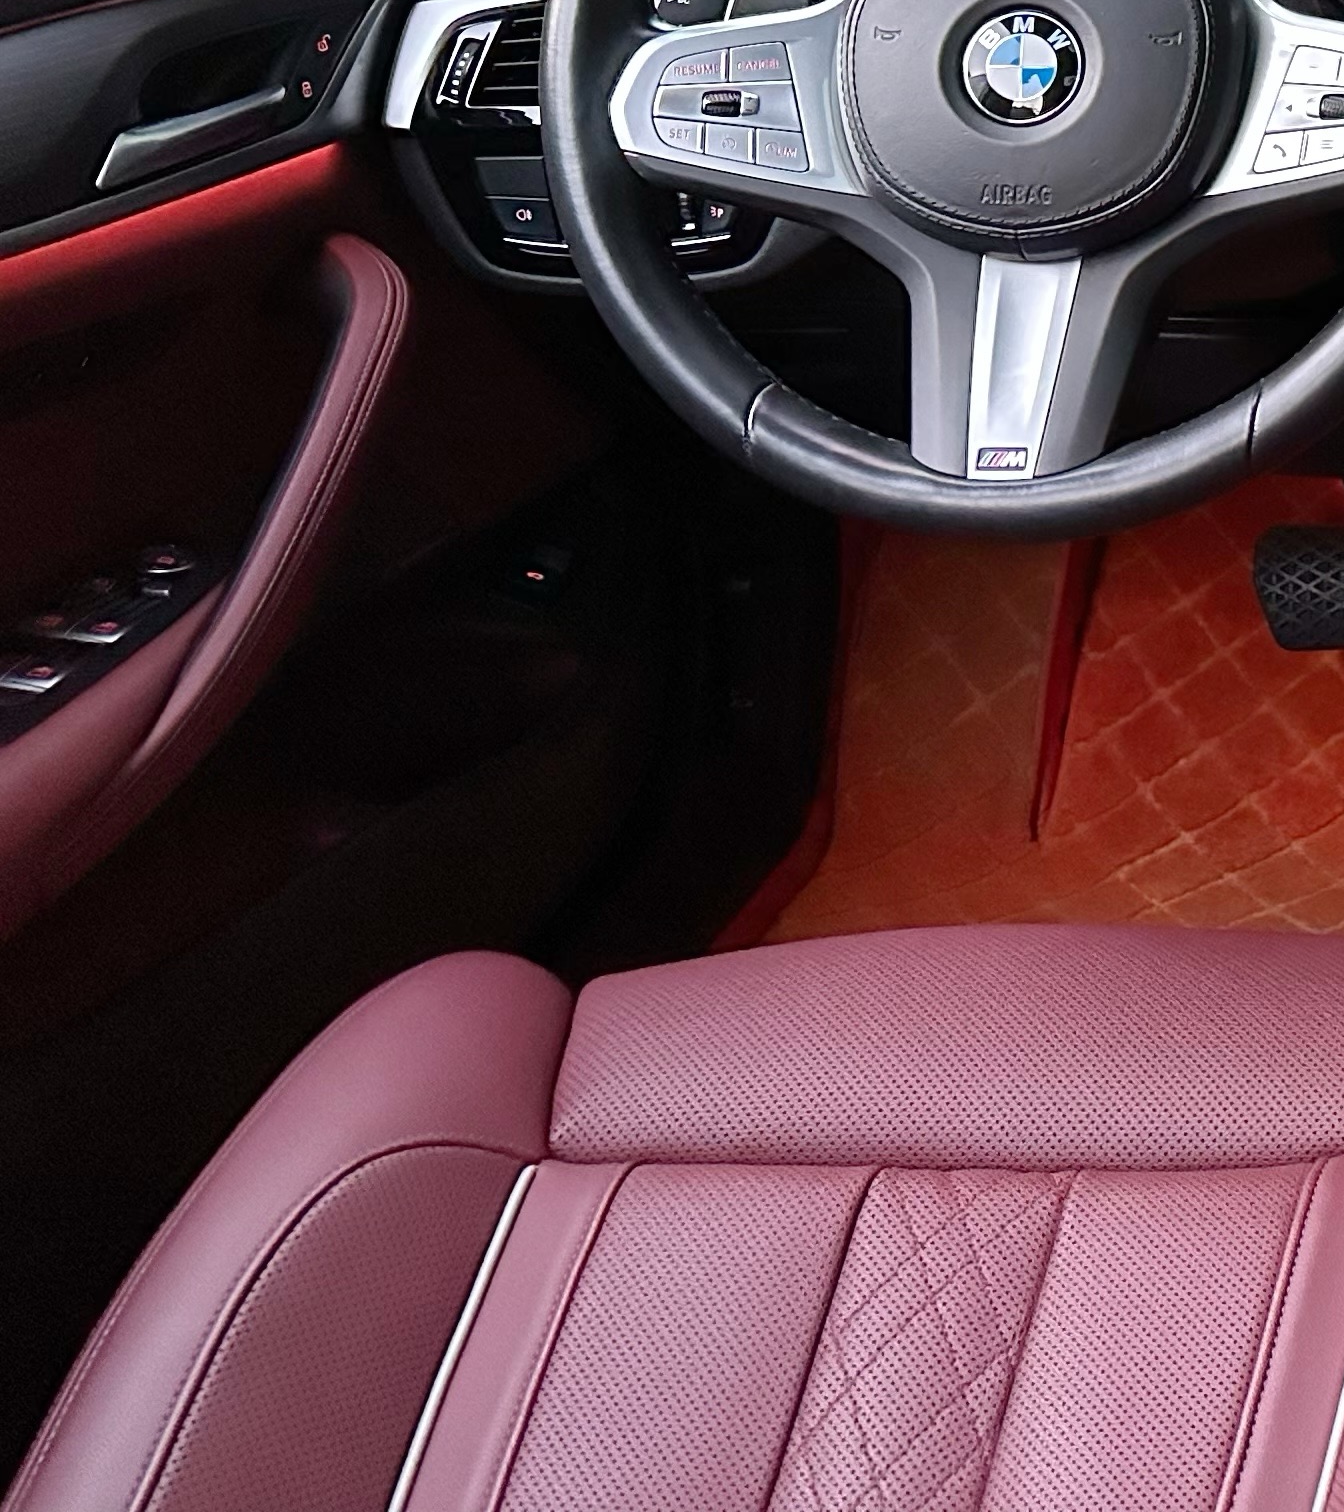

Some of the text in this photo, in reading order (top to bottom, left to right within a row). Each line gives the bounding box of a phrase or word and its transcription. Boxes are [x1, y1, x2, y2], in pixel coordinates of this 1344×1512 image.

[977, 15, 1072, 51] BMW
[672, 59, 780, 77] RESUME CANCEL
[668, 127, 690, 140] SET
[981, 184, 1053, 206] AIRBAG
